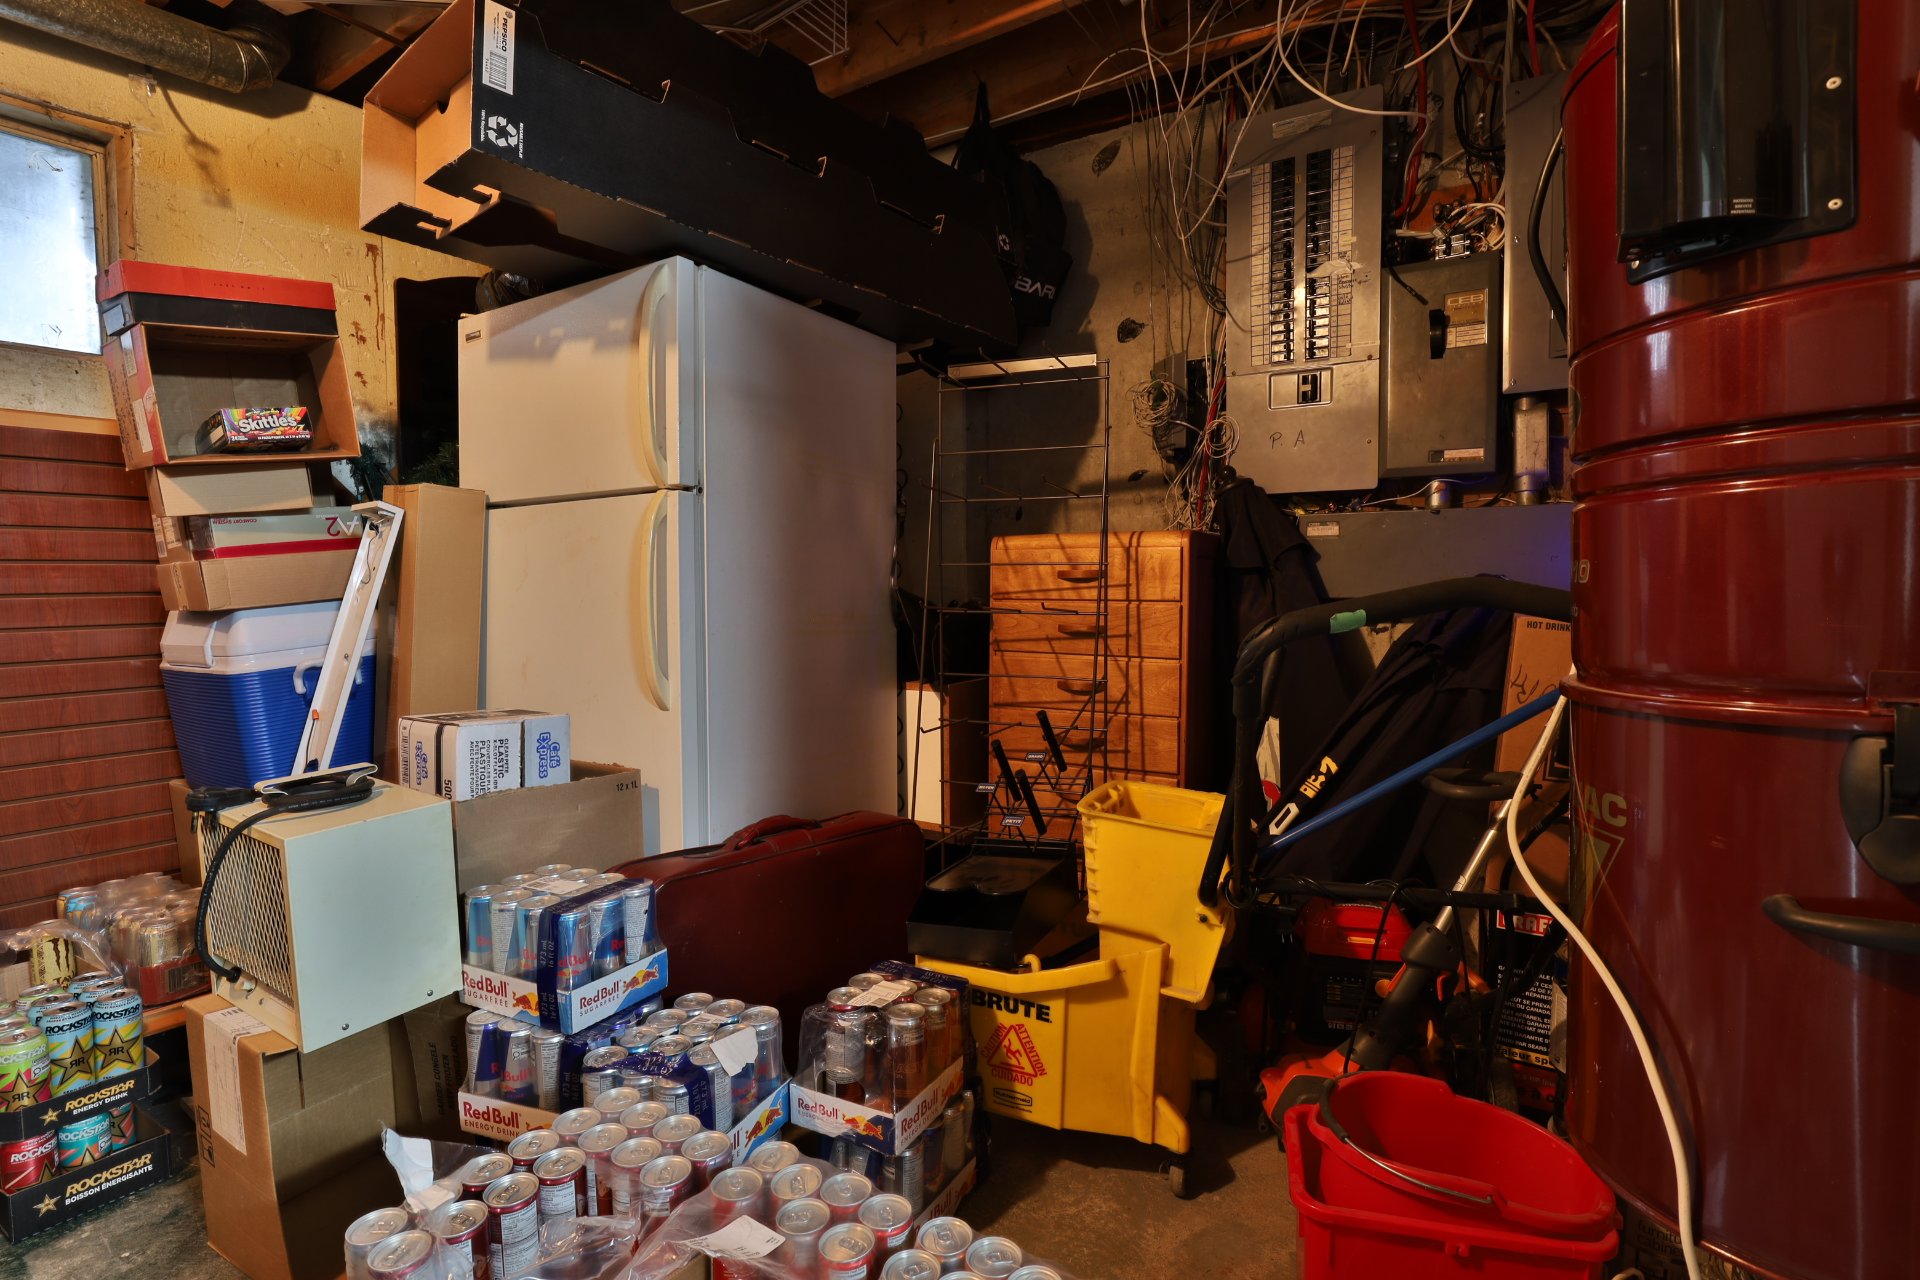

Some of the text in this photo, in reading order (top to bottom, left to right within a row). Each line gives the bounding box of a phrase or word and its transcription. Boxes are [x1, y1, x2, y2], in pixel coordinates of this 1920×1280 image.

[1448, 294, 1484, 306] CEB
[238, 414, 297, 433] Skittles
[1293, 429, 1305, 448] A
[1526, 620, 1544, 629] HOT
[550, 742, 561, 769] Café
[444, 779, 452, 800] 500
[616, 782, 624, 791] 12
[463, 989, 508, 1008] SUGARFREE
[579, 994, 620, 1017] SUGARFREE
[44, 1013, 92, 1034] ROCKSTA
[980, 1022, 1008, 1058] CAUTION
[1016, 1023, 1048, 1077] ATTENTION
[992, 1068, 1033, 1086] CUIDADO
[65, 1079, 135, 1112] ROCKSTAR
[73, 1092, 128, 1115] ENERGY DRINK
[58, 1118, 110, 1141] ROCKSTAR
[464, 1120, 494, 1132] ENERGY
[66, 1154, 152, 1198] ROCKSTAR
[65, 1187, 100, 1206] BOISSON
